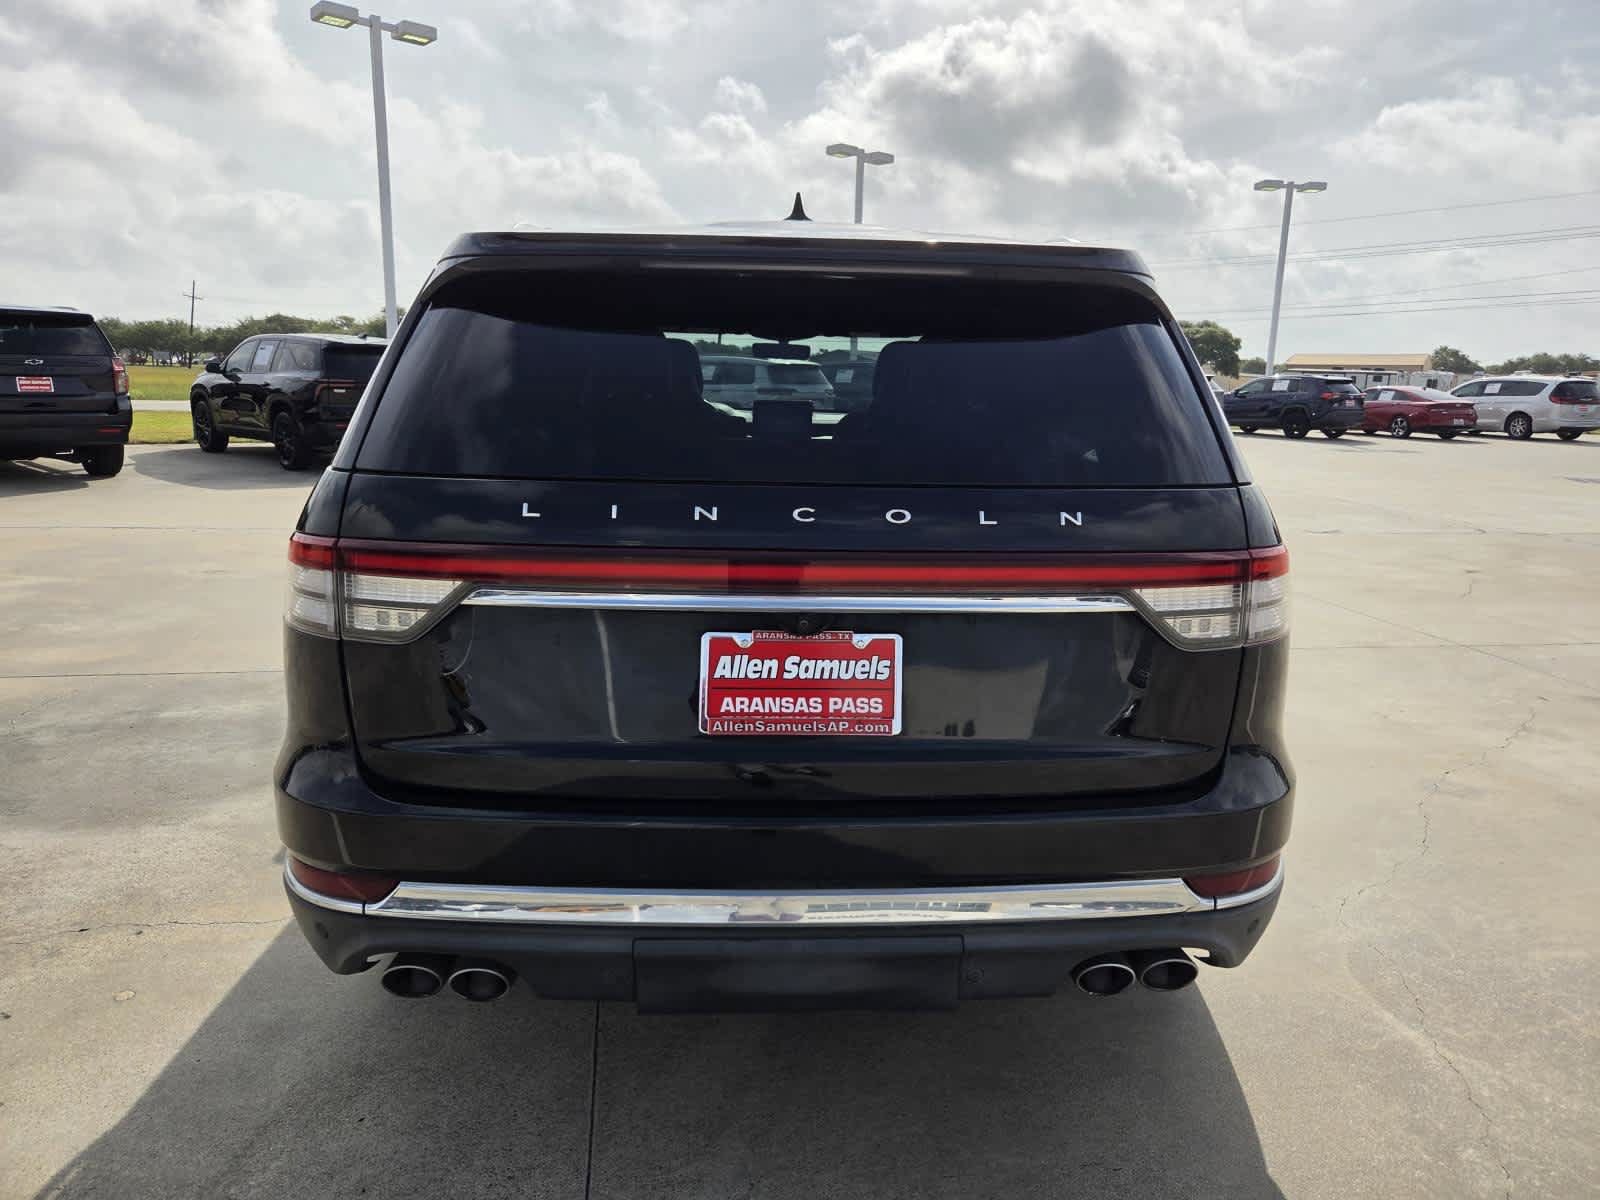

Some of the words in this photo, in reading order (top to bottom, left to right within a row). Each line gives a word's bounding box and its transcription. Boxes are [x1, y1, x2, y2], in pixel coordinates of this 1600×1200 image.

[522, 502, 1083, 527] LINCOLN
[713, 655, 779, 680] Allen
[783, 656, 892, 681] Samuels
[720, 697, 823, 713] ARANSAS
[829, 697, 883, 713] PASS
[712, 720, 890, 733] AllenSamuelsAP.com
